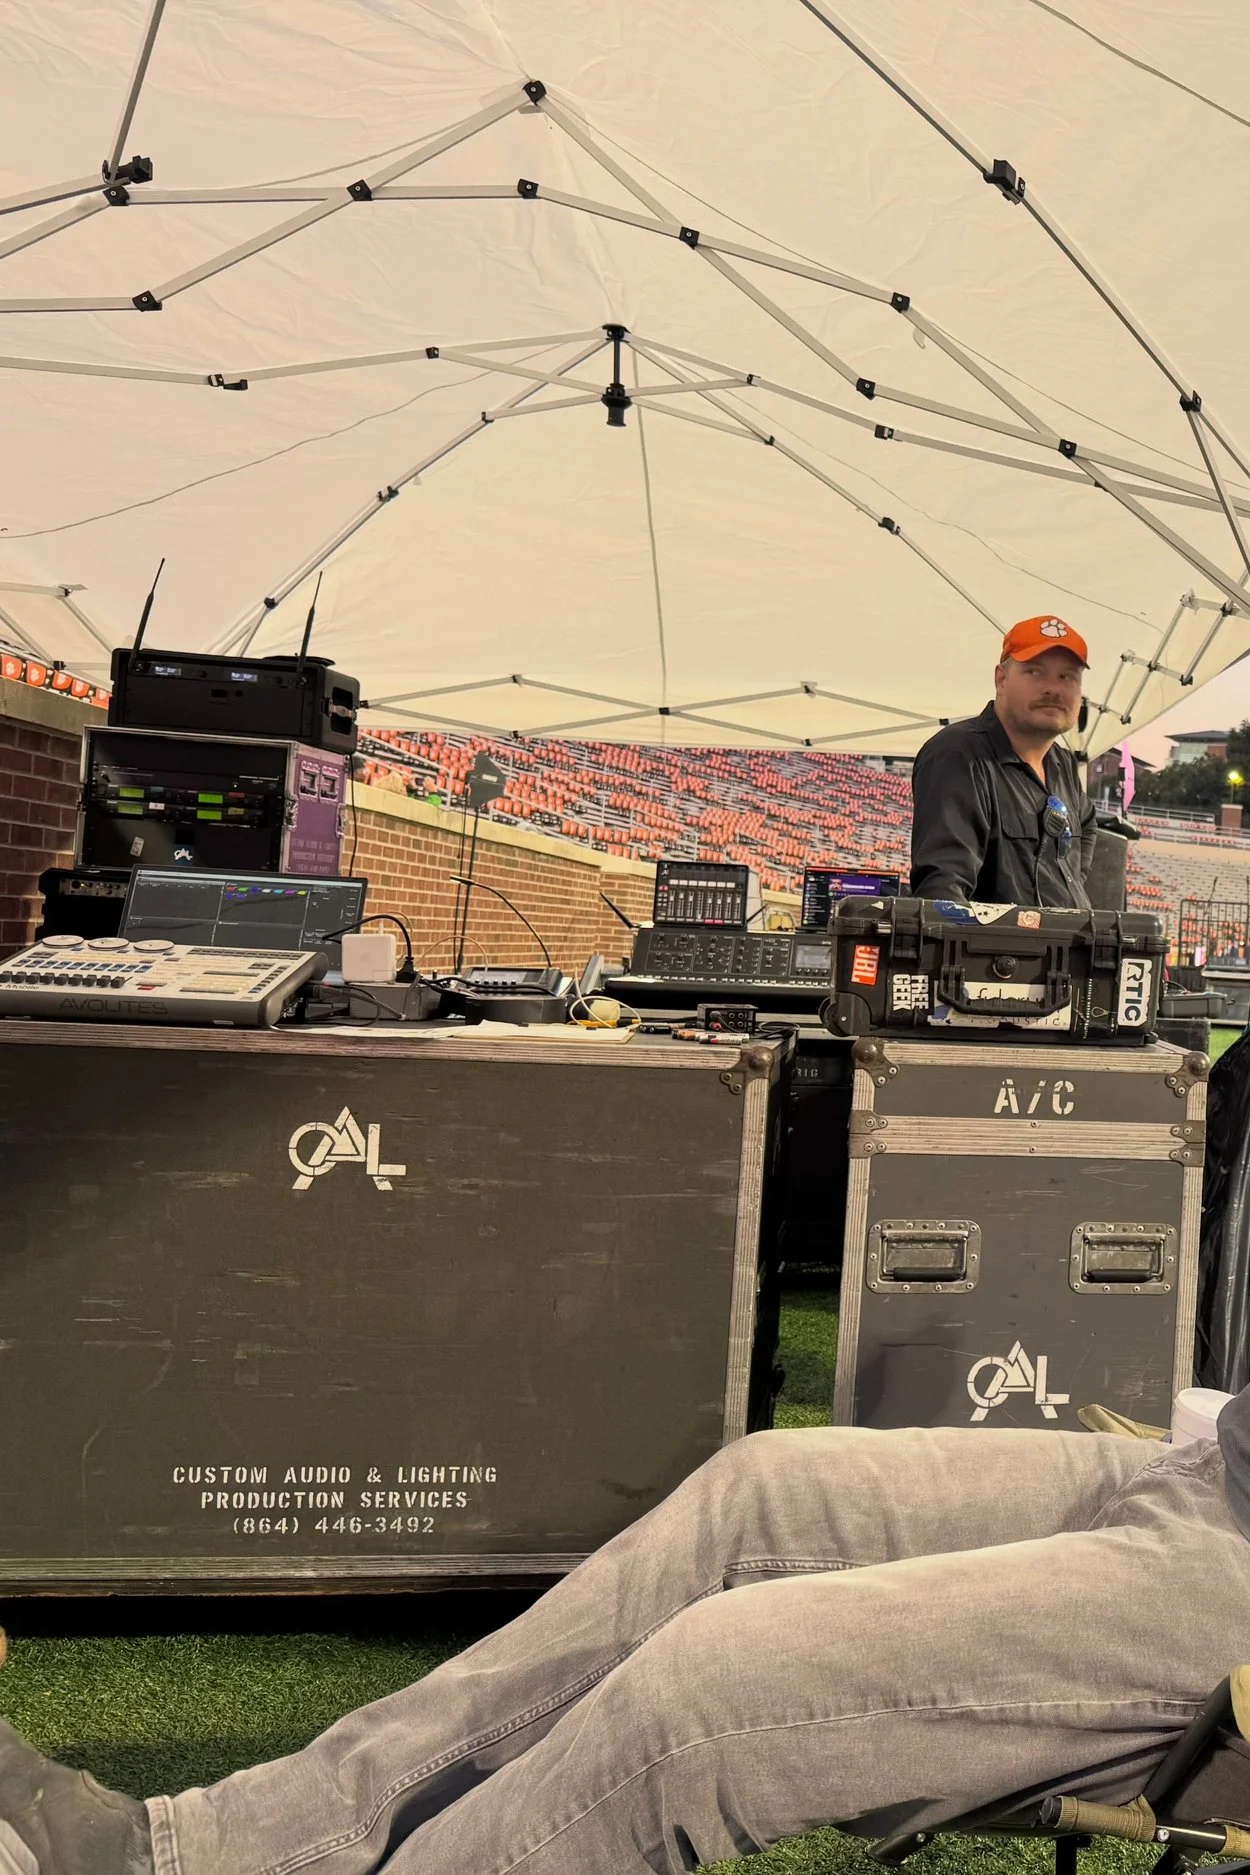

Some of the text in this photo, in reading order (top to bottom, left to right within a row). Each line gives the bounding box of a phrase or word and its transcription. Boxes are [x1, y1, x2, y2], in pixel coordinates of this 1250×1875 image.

[852, 946, 879, 985] JBL
[60, 997, 168, 1015] AVOLITES
[893, 974, 911, 1011] GEEK
[911, 975, 929, 1010] FREE
[1125, 962, 1145, 1022] RTIC
[994, 1079, 1074, 1115] A/C
[173, 1466, 497, 1484] CUSTOM AUDIO & LIGHTING
[201, 1491, 470, 1509] PRODUCTION SERVICES
[233, 1517, 434, 1534] (864) 446-3492
